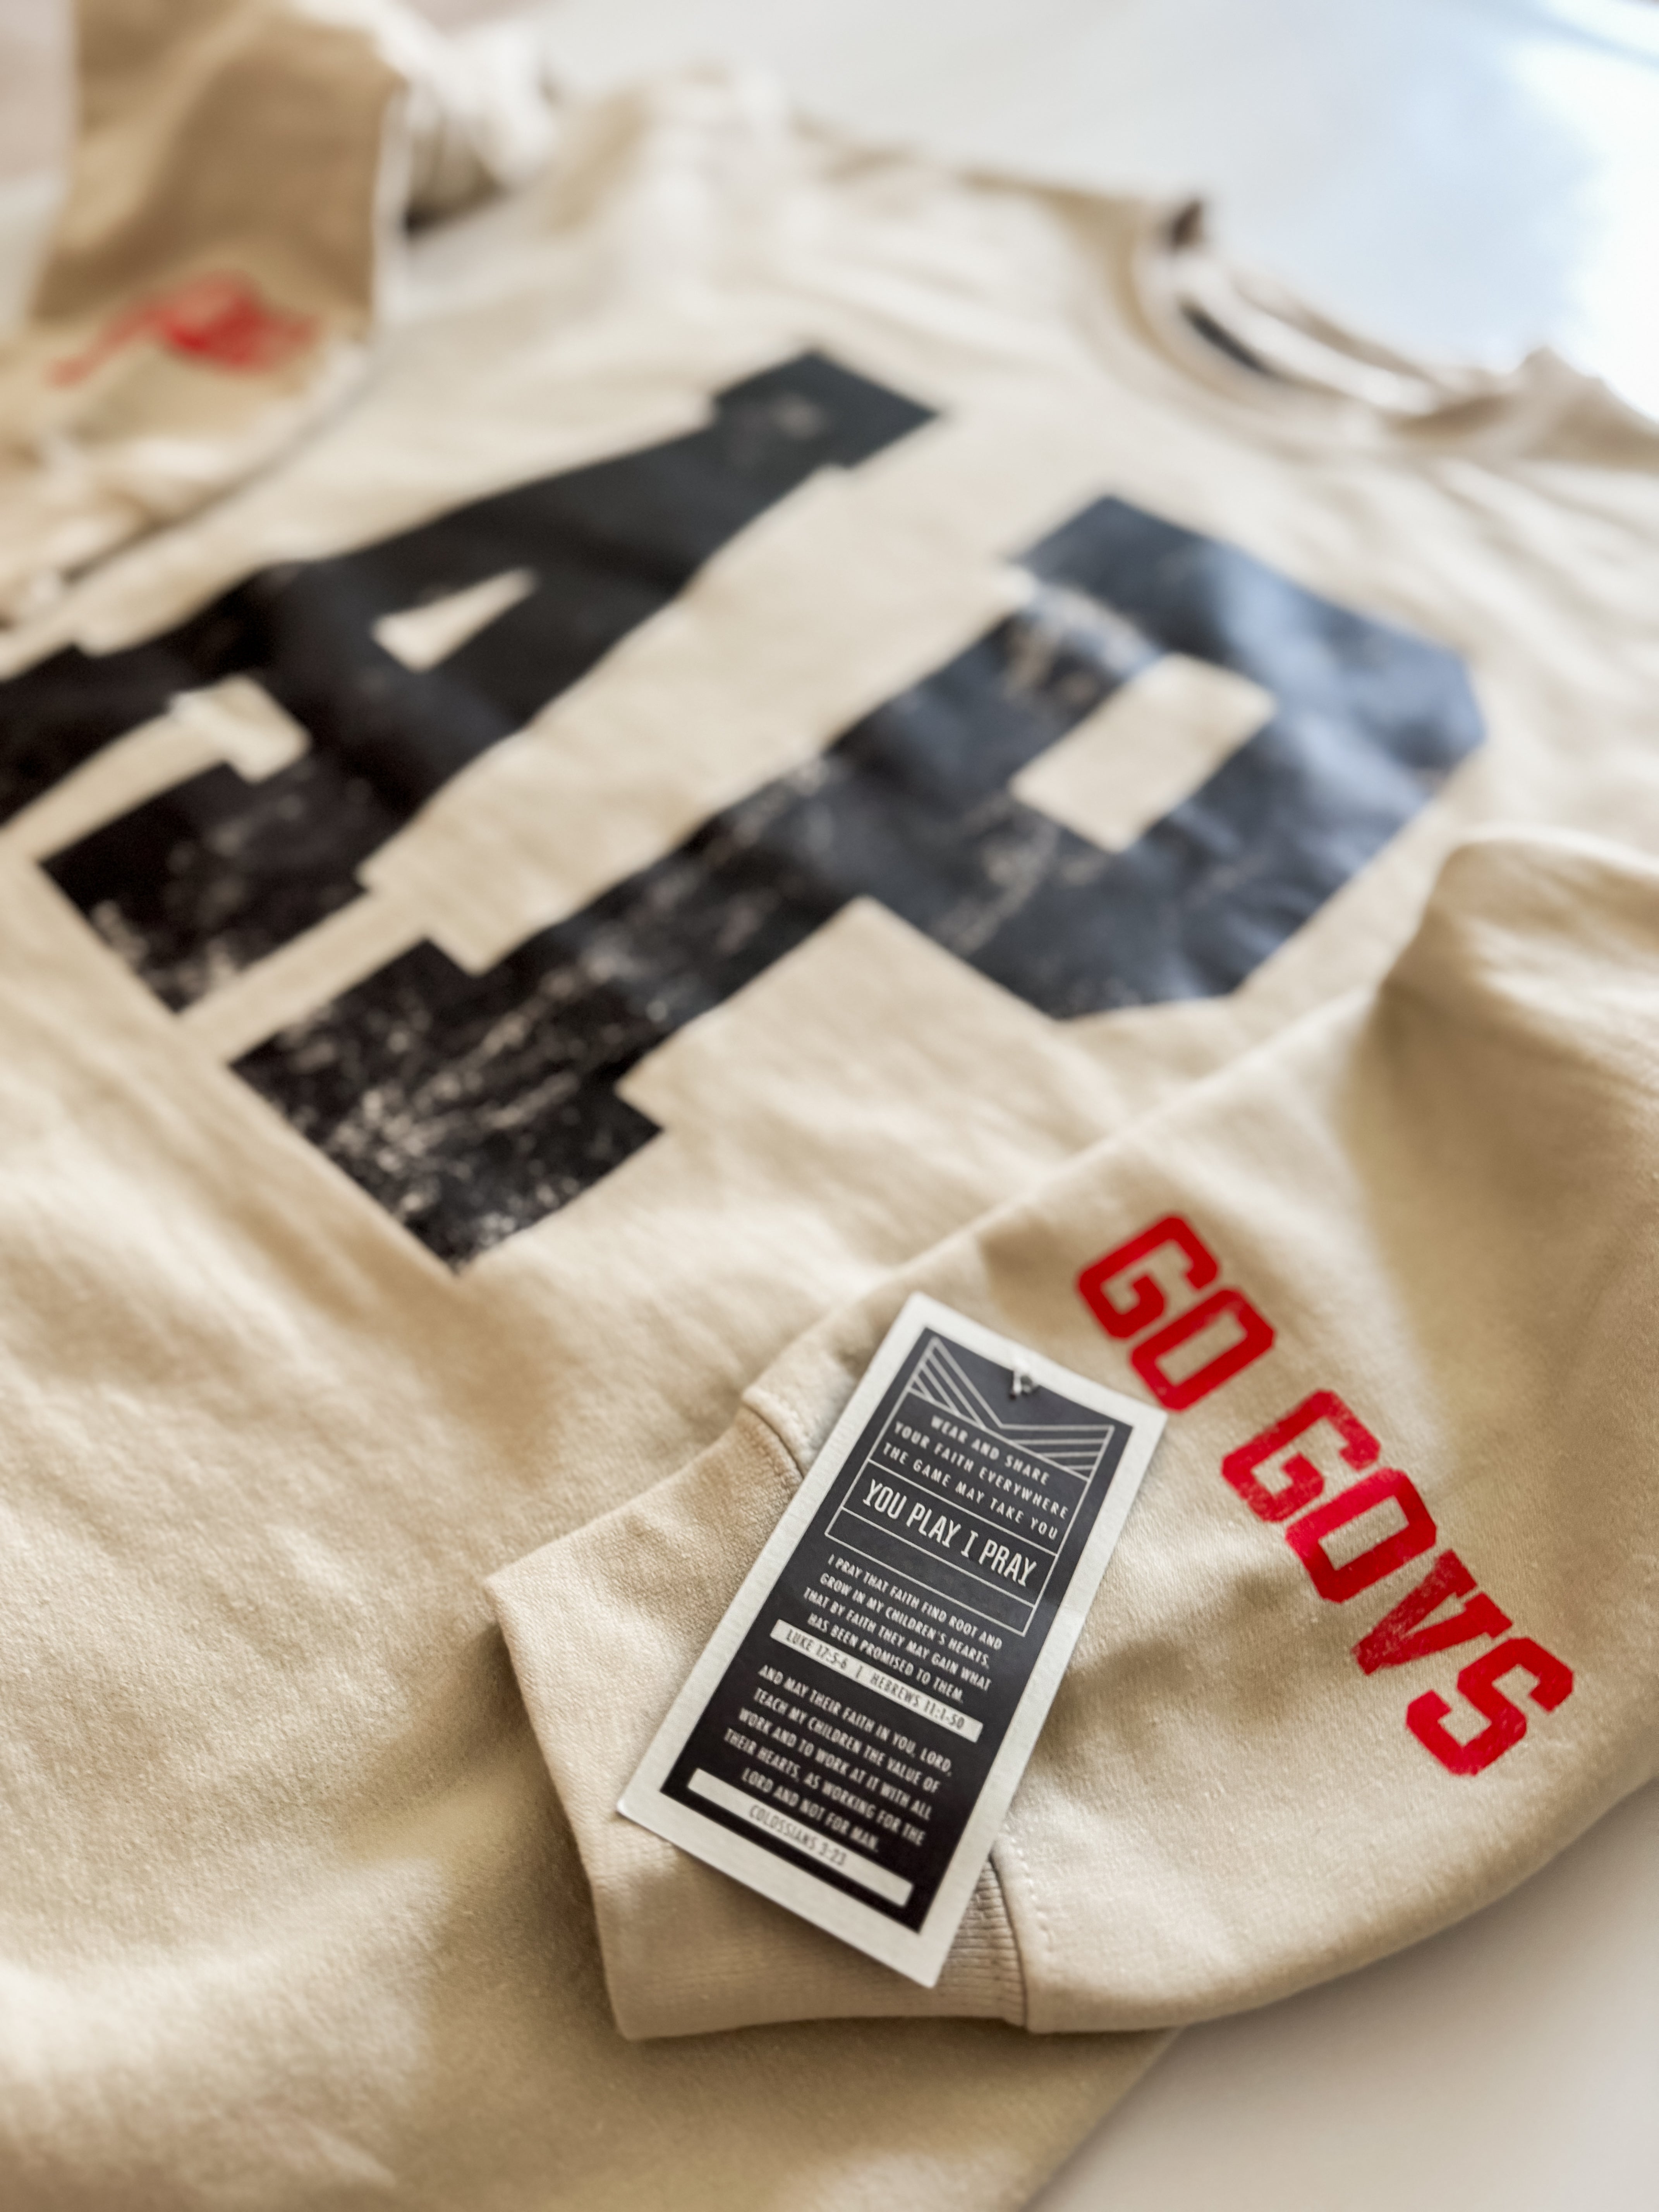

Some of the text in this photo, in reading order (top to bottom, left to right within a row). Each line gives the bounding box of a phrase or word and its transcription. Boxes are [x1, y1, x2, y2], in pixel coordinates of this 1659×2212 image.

[0, 350, 1488, 1275] AP
[882, 1441, 1058, 1540] THE GAME MAY TAKE YOU
[894, 1420, 1068, 1520] YOUR FAITH EVERYWHERE
[930, 1415, 1050, 1486] WEAR AND SHARE
[1075, 1212, 1575, 1776] GO GOVS
[862, 1478, 1037, 1587] YOU PLAY I PRAY
[802, 1586, 992, 1692] THAT BY FAITH THEY MAY GAIN WHAT
[819, 1572, 853, 1597] GROW
[851, 1588, 867, 1605] IN
[865, 1596, 885, 1614] MY
[827, 1553, 1003, 1650] I PRAY THAT FAITH FIND ROOT AND
[785, 1628, 814, 1652] LUKE
[815, 1643, 848, 1670] 17:5-6
[869, 1672, 920, 1707] HEBREWS
[806, 1612, 830, 1633] HAS
[830, 1624, 859, 1648] BEEN
[859, 1638, 914, 1676] PROMISED
[915, 1667, 932, 1685] TO
[753, 1686, 941, 1793] TEACH MY CHILDREN THE VALUE OF
[757, 1664, 784, 1685] AND
[783, 1676, 809, 1698] MAY
[808, 1688, 842, 1716] THEIR
[841, 1706, 875, 1733] FAITH
[874, 1724, 891, 1741] IN
[723, 1727, 757, 1755] THEIR
[803, 1771, 821, 1790] AS
[821, 1781, 876, 1819] WORKING
[876, 1809, 902, 1832] FOR
[902, 1822, 926, 1846] THE
[738, 1707, 932, 1820] WORK AND TO WORK AT IT WITH ALL
[741, 1767, 774, 1793] LORD
[773, 1785, 799, 1807] AND
[799, 1798, 826, 1820] NOT
[824, 1812, 850, 1835] FOR
[748, 1804, 817, 1851] COLOSSIANS
